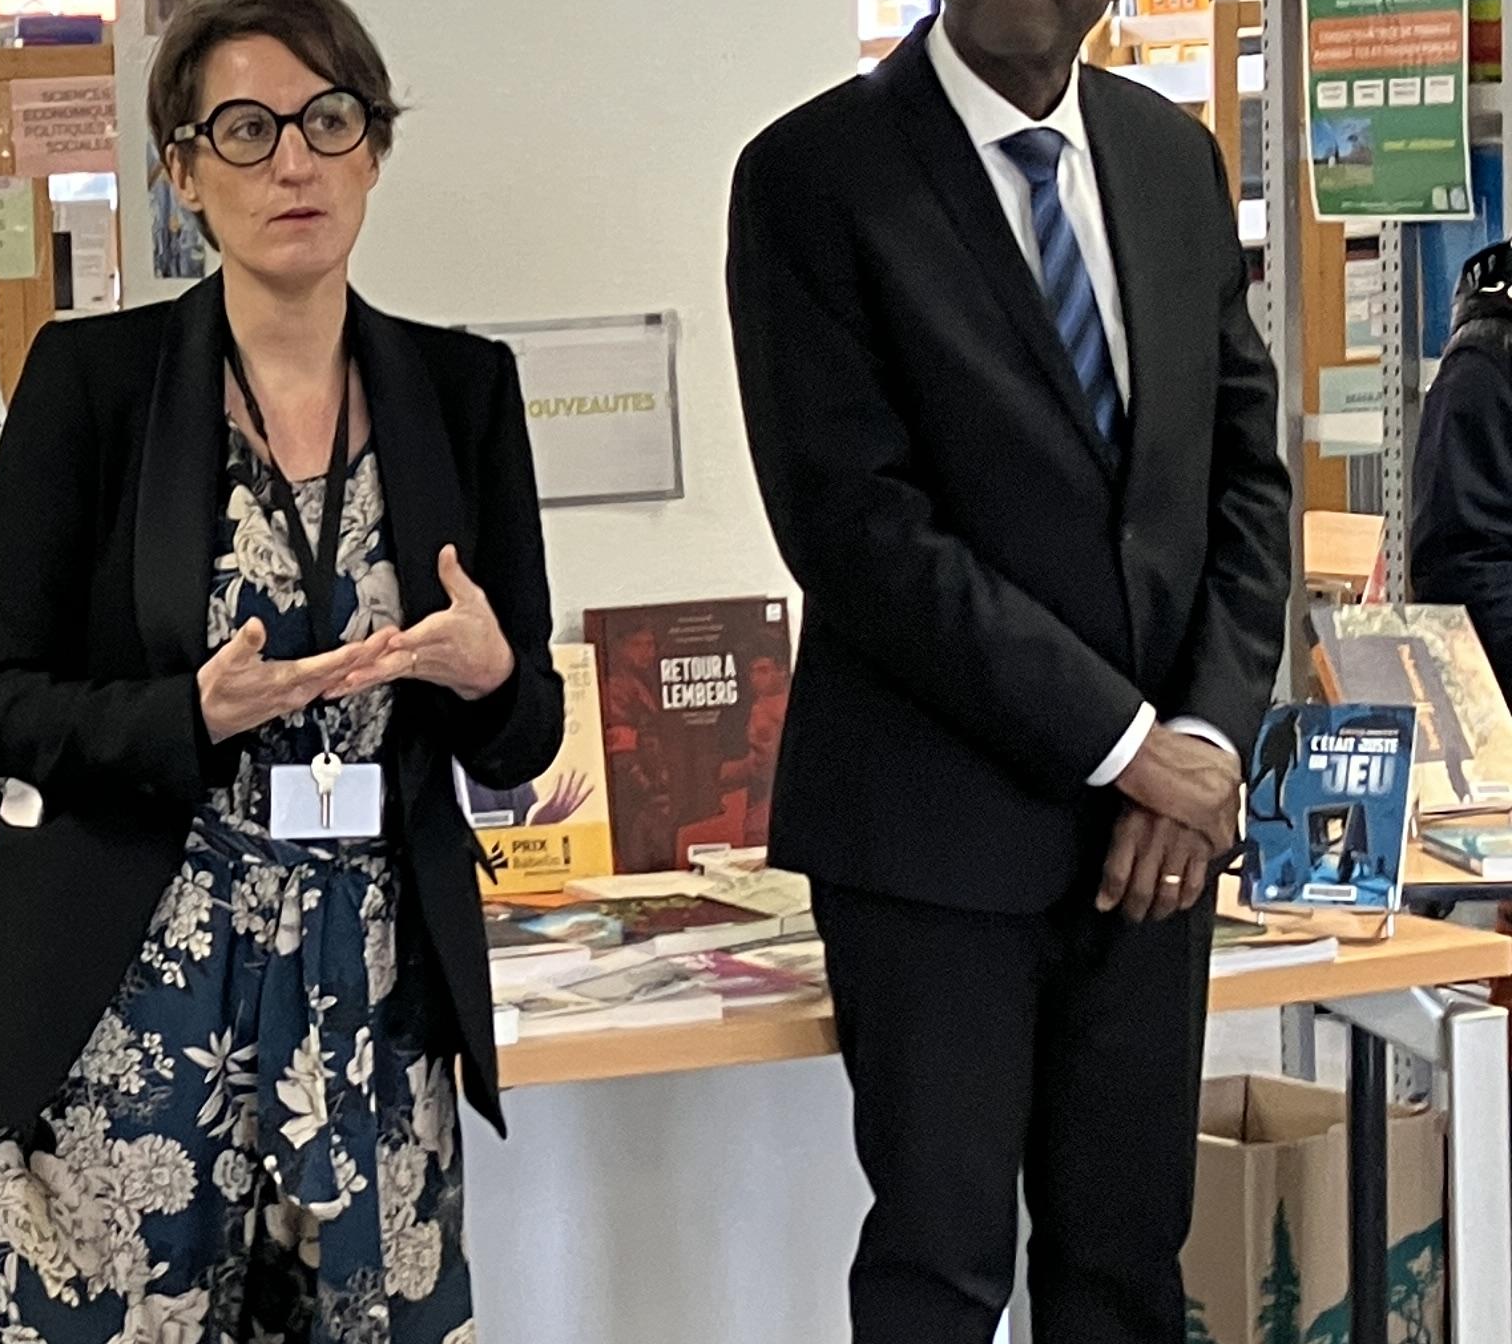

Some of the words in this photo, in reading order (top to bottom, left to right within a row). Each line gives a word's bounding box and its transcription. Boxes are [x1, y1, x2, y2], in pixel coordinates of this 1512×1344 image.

[23, 104, 115, 122] ECONOMIQUE
[527, 391, 656, 419] OUVEAUTES
[660, 654, 723, 684] RETOUR
[662, 679, 738, 710] LEMBERG
[1357, 737, 1399, 754] JUSTE
[1322, 755, 1396, 795] JEU
[512, 840, 547, 853] PRIX
